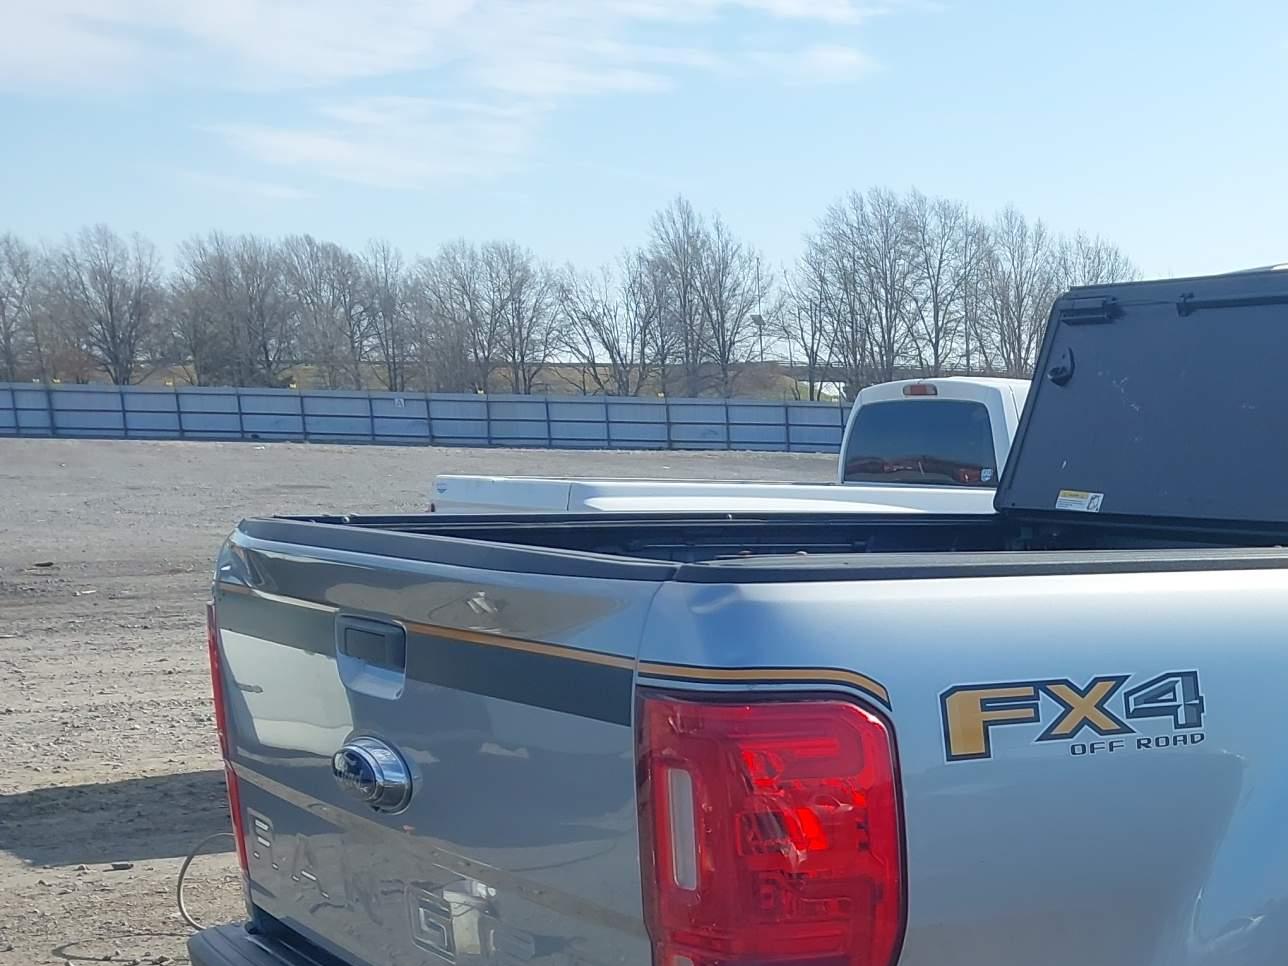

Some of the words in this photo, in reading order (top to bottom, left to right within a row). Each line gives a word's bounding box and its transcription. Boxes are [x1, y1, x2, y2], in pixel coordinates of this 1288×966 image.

[940, 670, 1205, 762] FX4
[1071, 740, 1125, 756] OFF
[1136, 733, 1205, 749] ROAD
